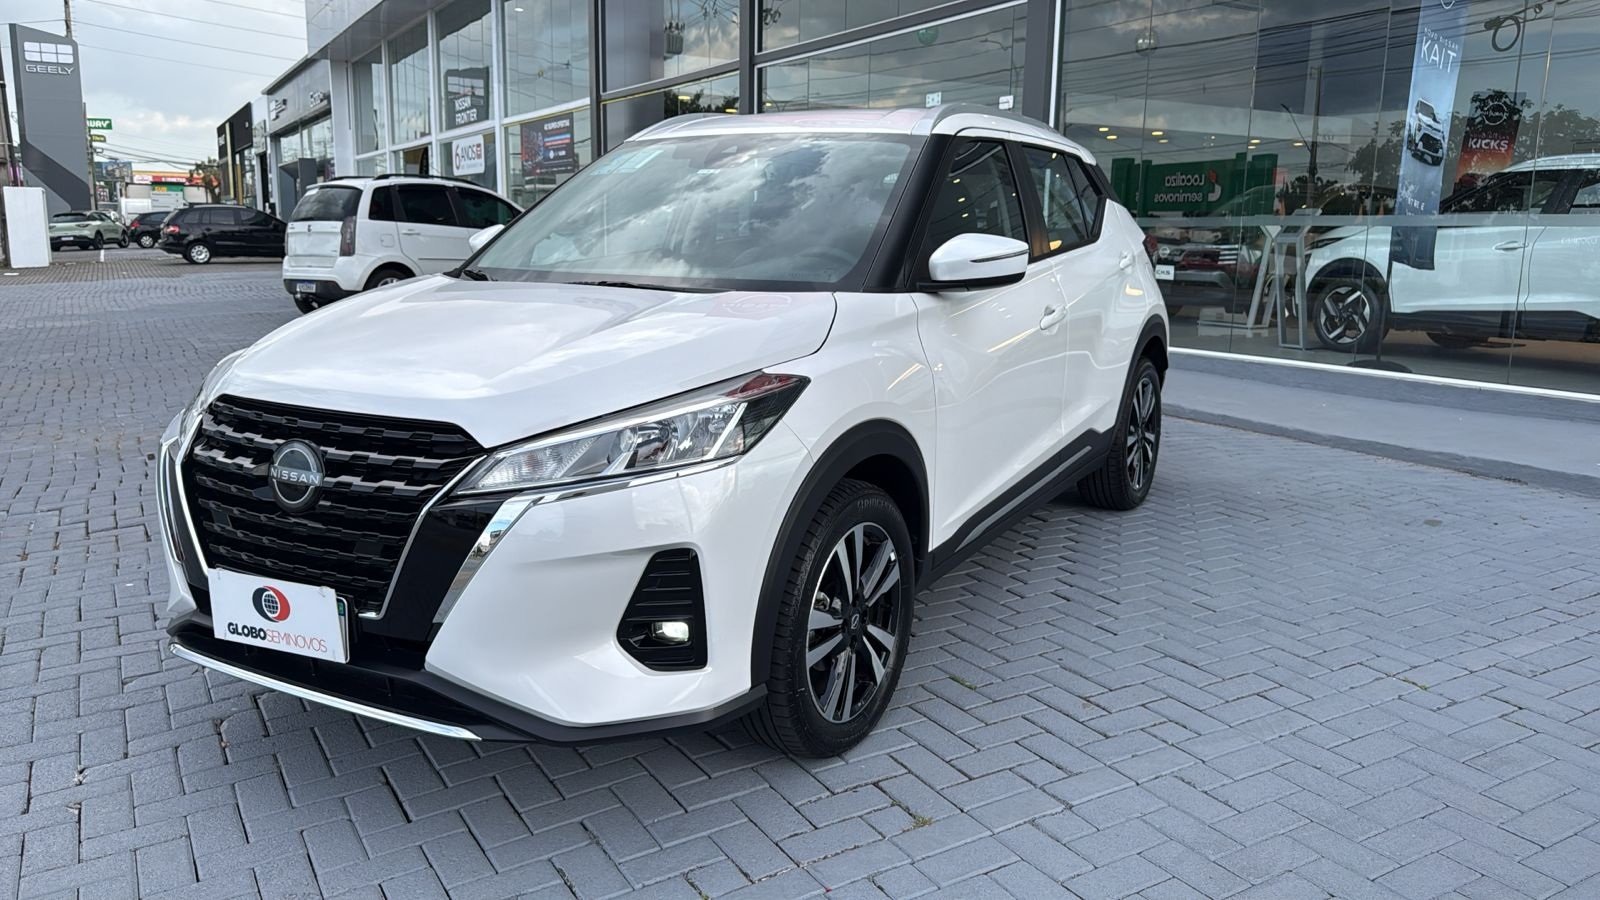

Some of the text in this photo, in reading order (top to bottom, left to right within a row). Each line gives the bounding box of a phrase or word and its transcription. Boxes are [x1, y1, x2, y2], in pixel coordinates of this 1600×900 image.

[1421, 36, 1457, 73] KAIT
[25, 64, 74, 75] GEELY
[86, 120, 110, 129] WAY
[455, 108, 478, 126] FRONTIER
[1468, 138, 1509, 151] KICKS
[454, 143, 461, 170] 6
[270, 467, 320, 484] NISSAN
